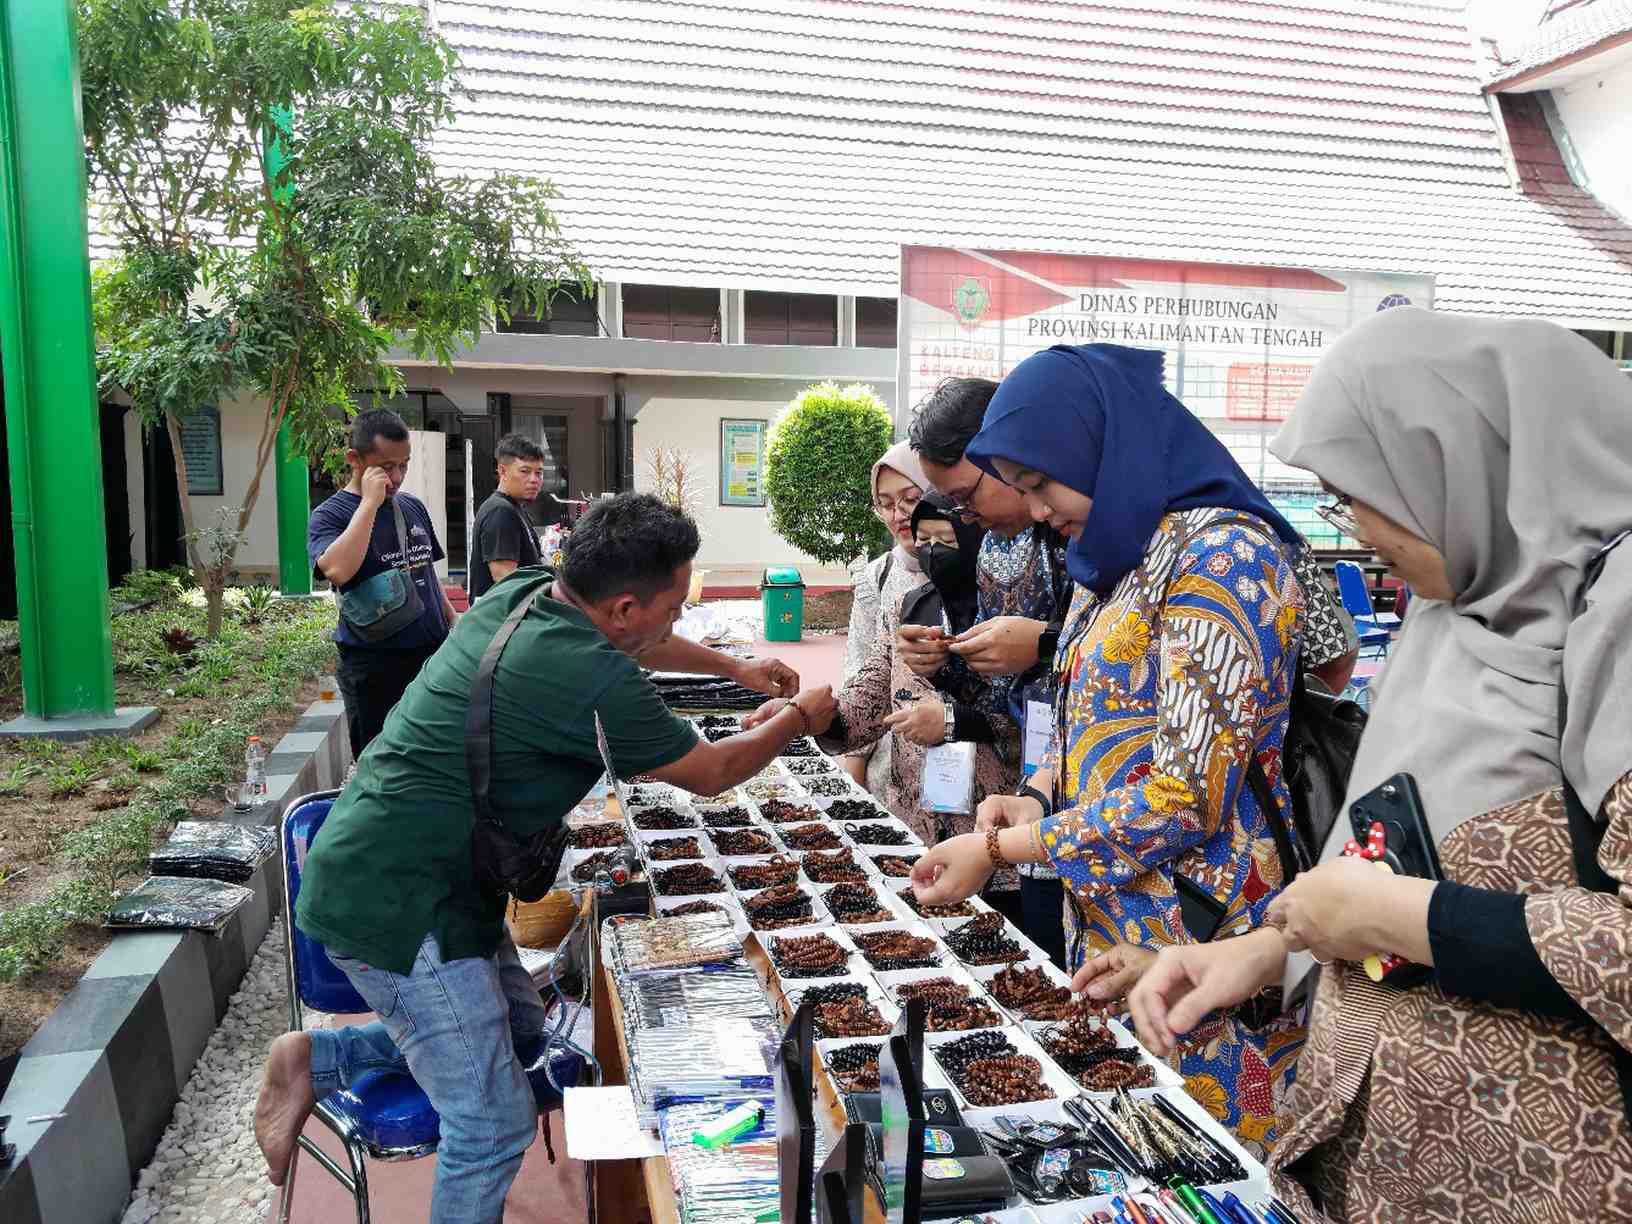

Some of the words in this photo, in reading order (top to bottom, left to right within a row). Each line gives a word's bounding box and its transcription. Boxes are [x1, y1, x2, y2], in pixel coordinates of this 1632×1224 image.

[1080, 294, 1137, 314] DINAS
[1144, 296, 1278, 321] PERHUBUNGAN
[1028, 318, 1116, 339] PROVINSI
[1123, 322, 1245, 345] KALIMANTAN
[1251, 327, 1323, 348] TENGAH
